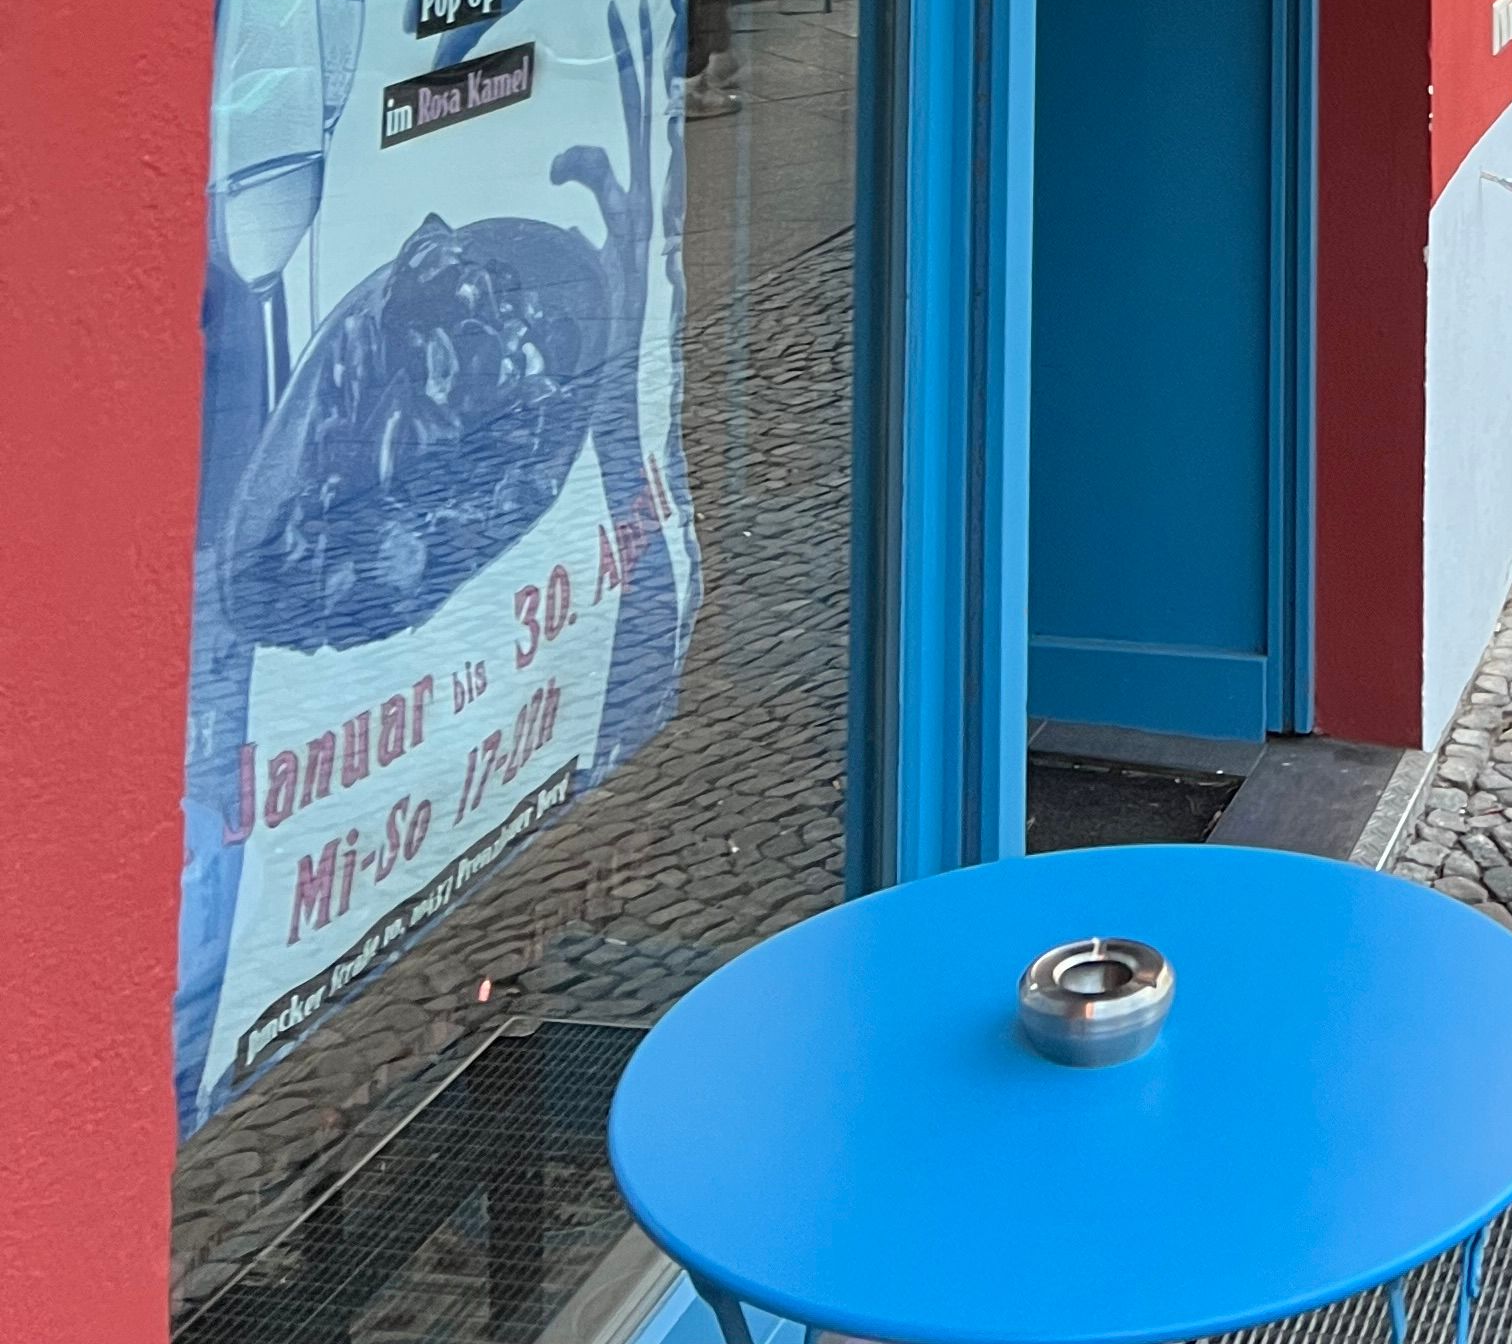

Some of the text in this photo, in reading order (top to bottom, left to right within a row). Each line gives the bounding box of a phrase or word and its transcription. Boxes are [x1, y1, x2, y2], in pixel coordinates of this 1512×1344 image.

[386, 56, 529, 136] im Rosa Kamel
[223, 675, 434, 846] Januar
[452, 660, 488, 714] bis
[515, 564, 577, 669] 30.
[288, 795, 432, 948] Mi-So
